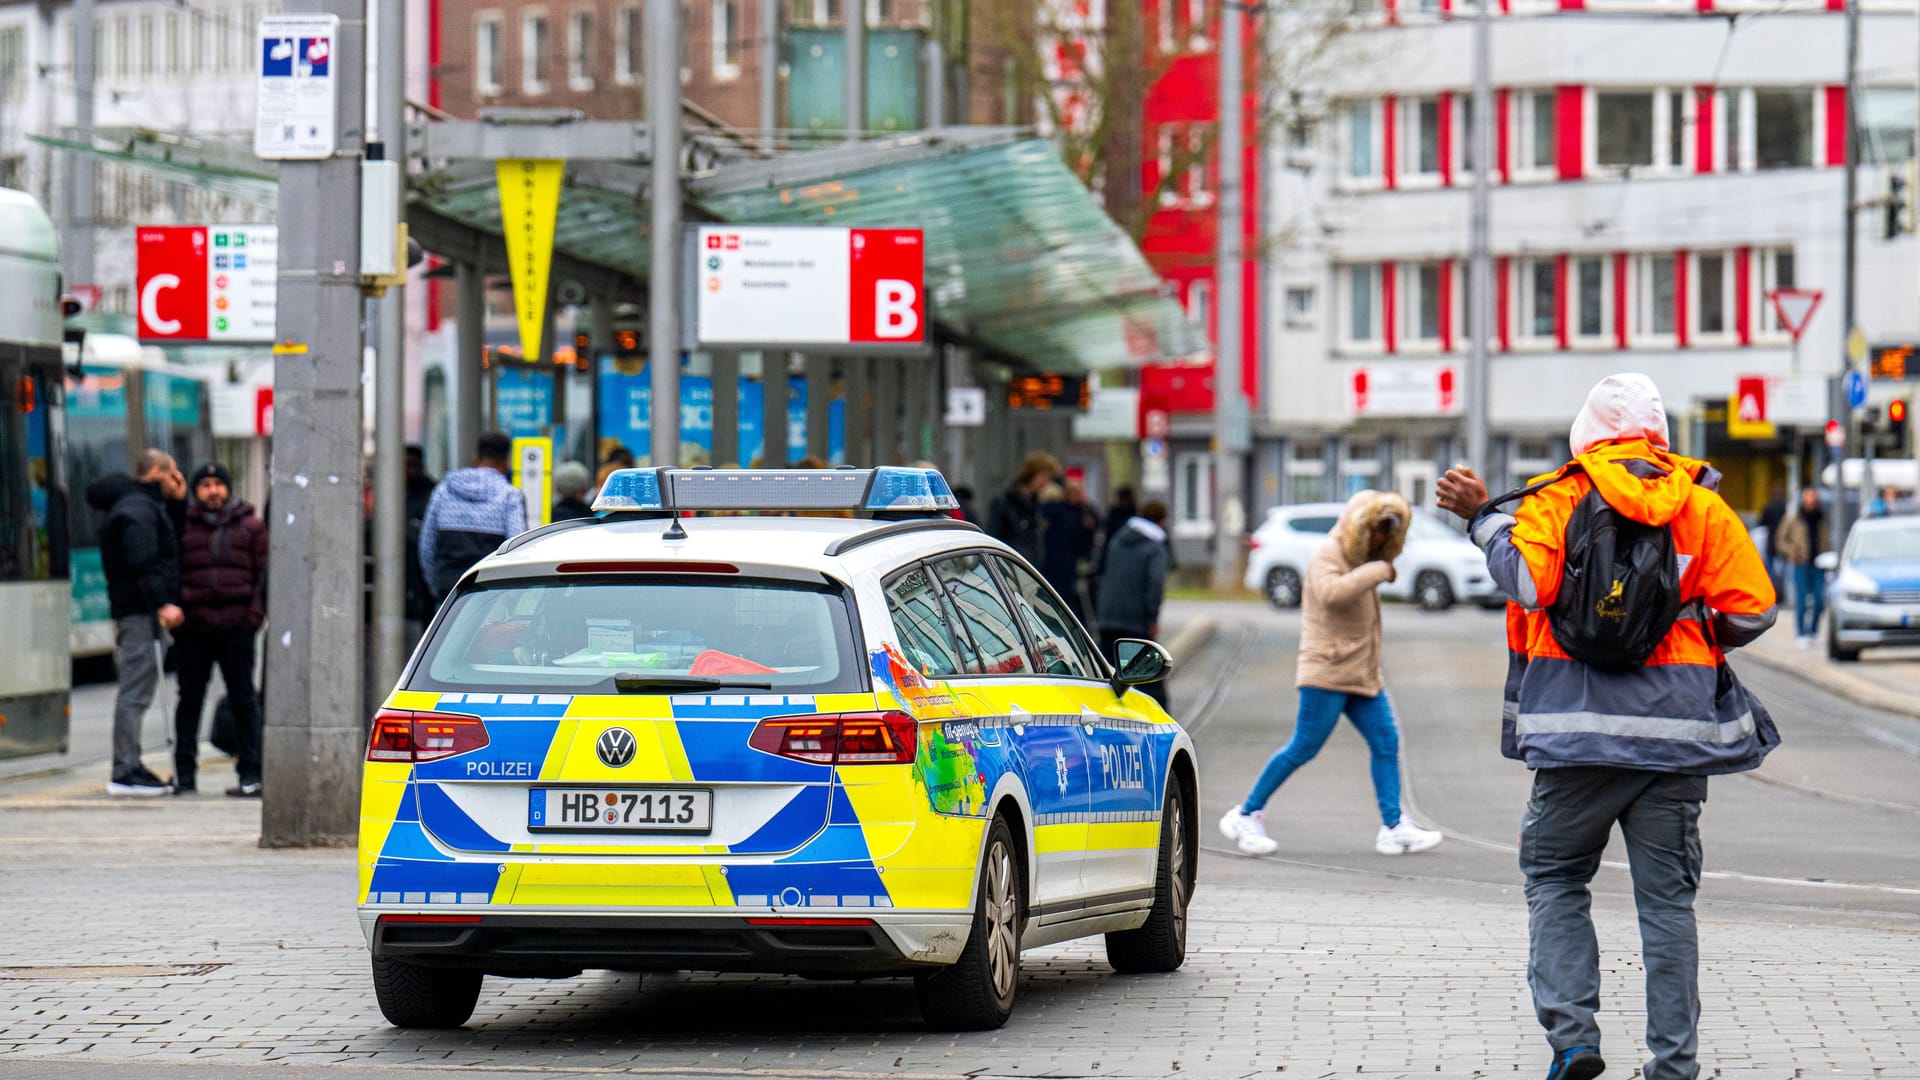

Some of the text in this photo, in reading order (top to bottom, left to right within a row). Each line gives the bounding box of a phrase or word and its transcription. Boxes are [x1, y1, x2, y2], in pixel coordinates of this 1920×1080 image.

[141, 273, 182, 335] C
[875, 279, 918, 338] B
[1739, 393, 1761, 420] A
[466, 762, 532, 777] POLIZEI
[1100, 744, 1144, 790] POLIZEI
[534, 811, 541, 820] D
[561, 793, 695, 824] HB 7113
